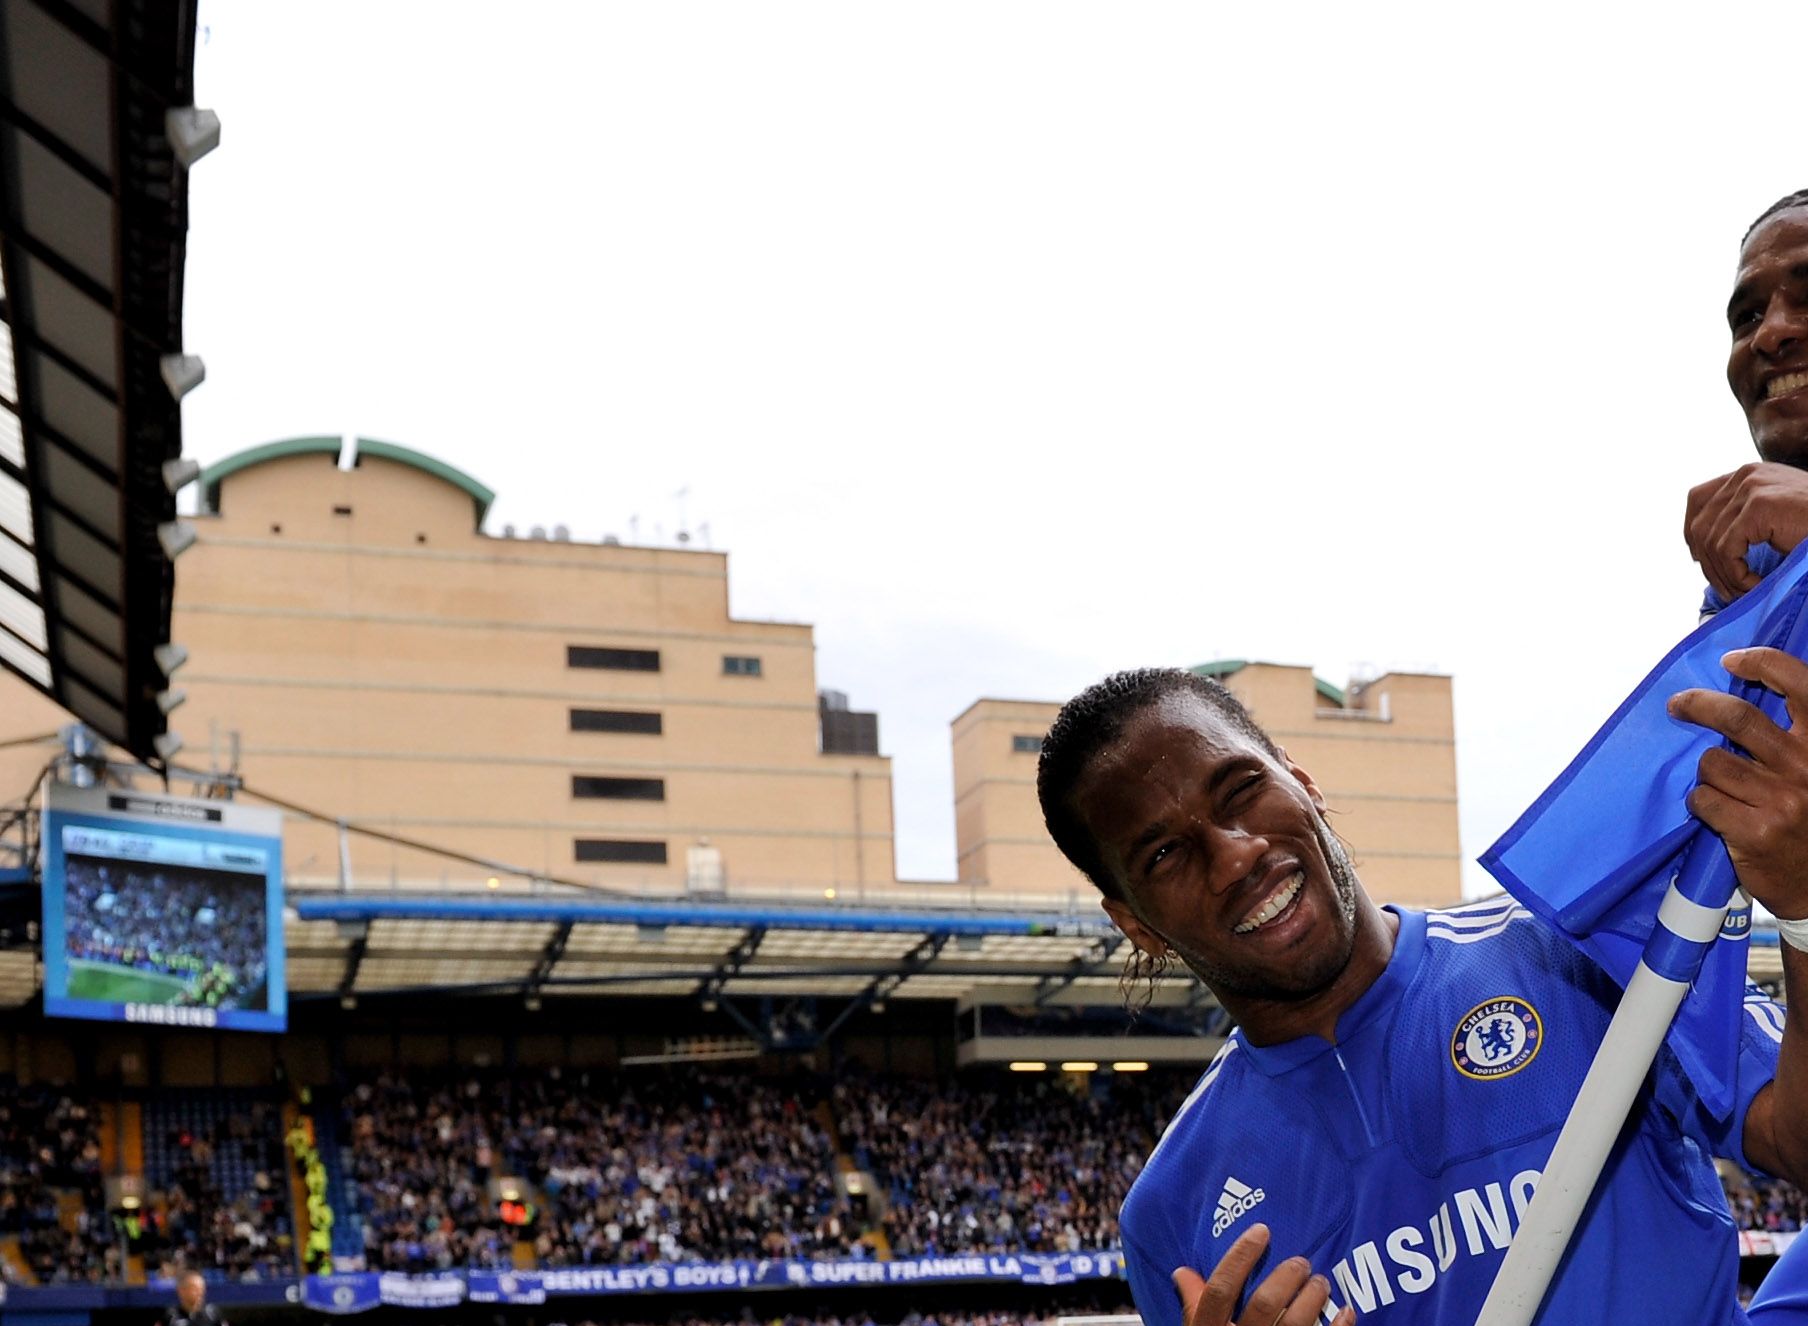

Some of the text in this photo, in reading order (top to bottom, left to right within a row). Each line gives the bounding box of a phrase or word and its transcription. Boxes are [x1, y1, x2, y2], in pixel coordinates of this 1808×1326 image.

[1724, 914, 1748, 928] UB
[125, 1003, 217, 1028] SAMSUNG
[1462, 1002, 1515, 1032] CHELSEA
[1473, 1049, 1531, 1075] FOOTBALL CLUB
[1212, 1188, 1265, 1238] adidas
[543, 1268, 669, 1290] BENTLEY'S
[811, 1261, 885, 1282] SUPER
[889, 1258, 986, 1279] FRANKIE
